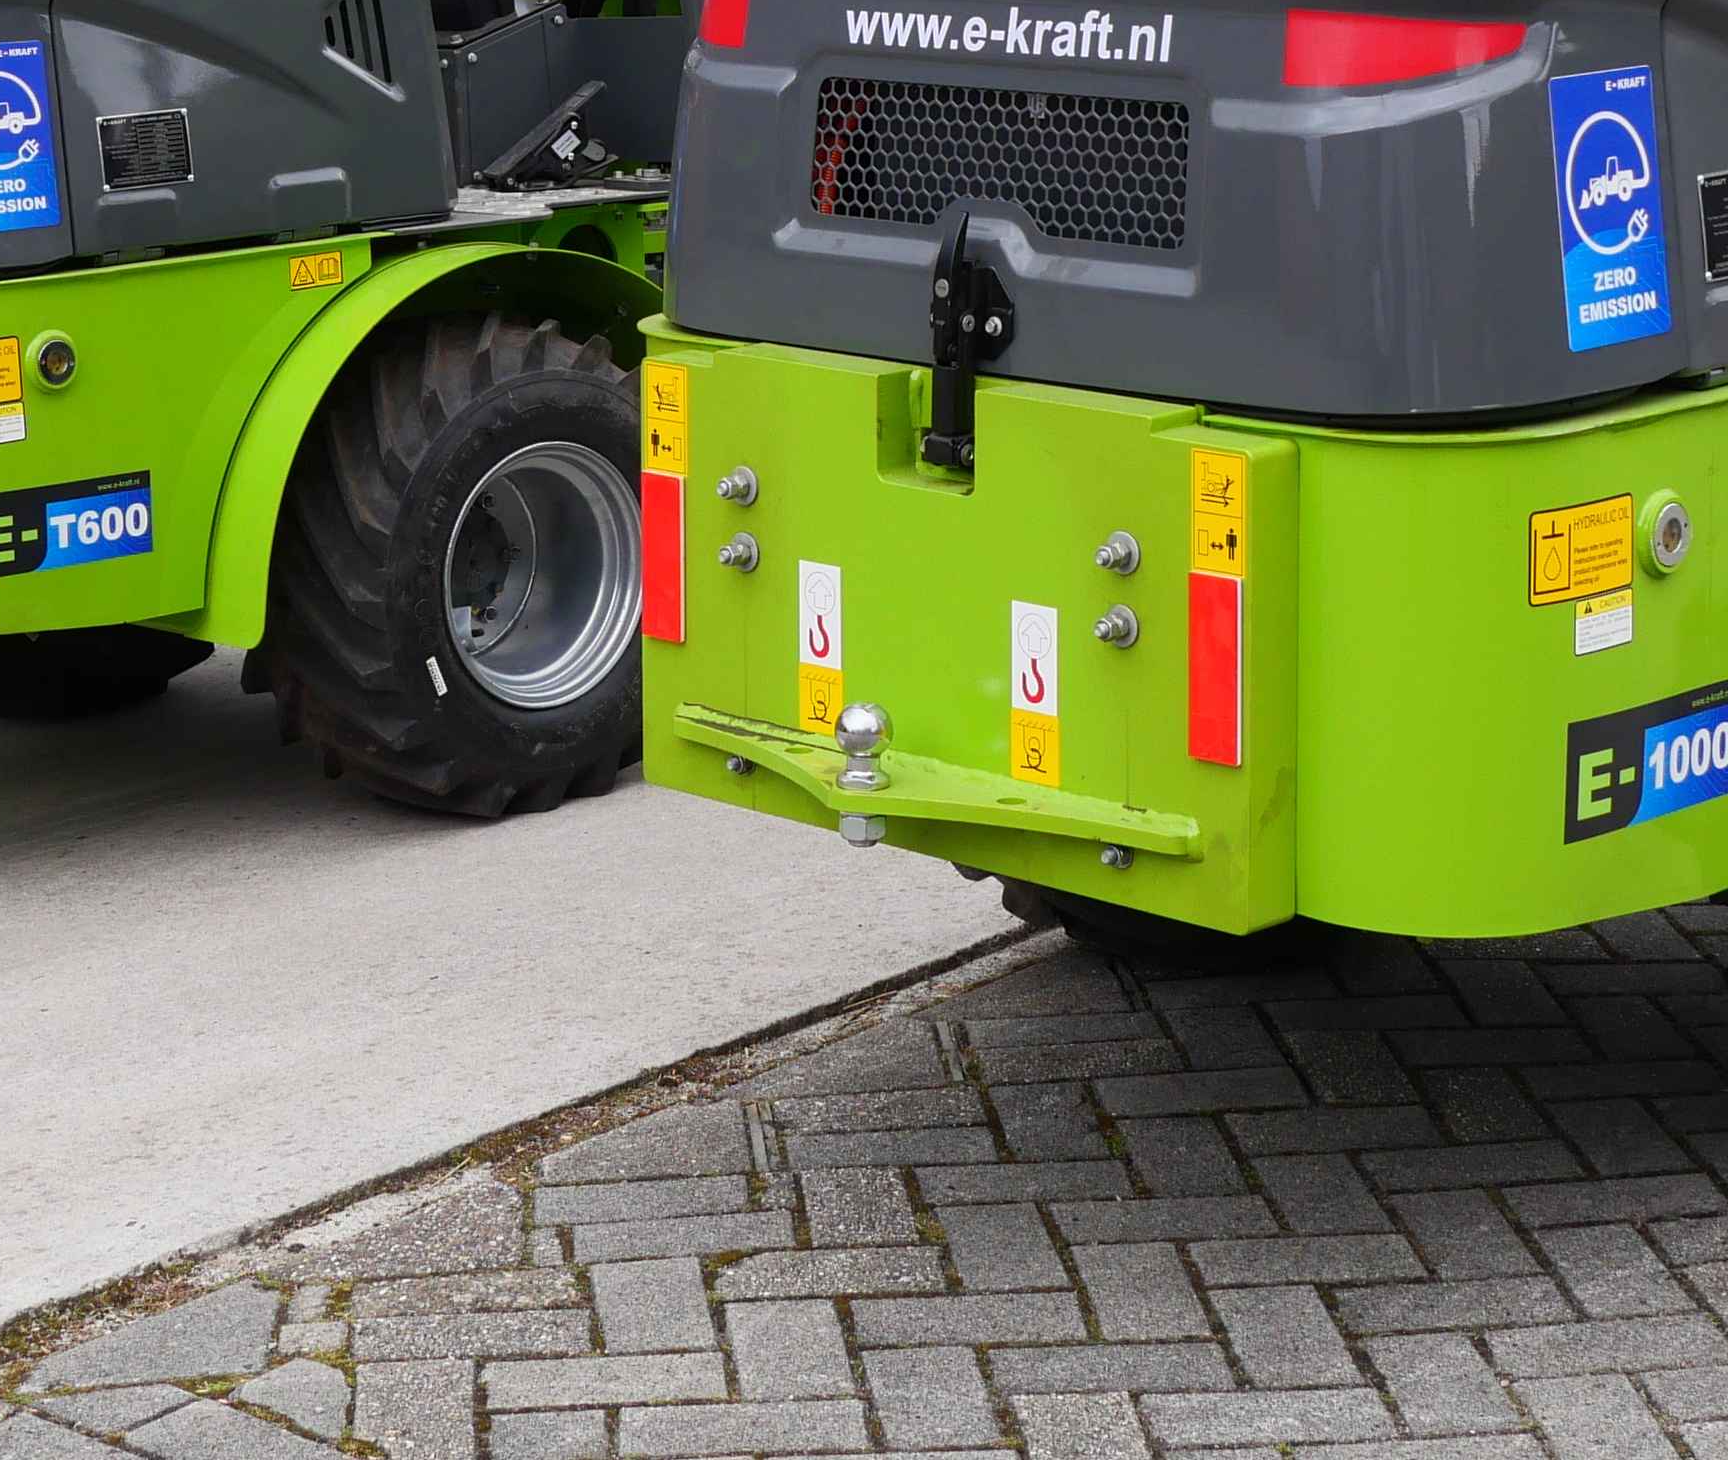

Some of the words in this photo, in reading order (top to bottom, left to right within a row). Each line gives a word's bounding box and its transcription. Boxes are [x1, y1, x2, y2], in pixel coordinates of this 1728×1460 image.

[846, 7, 1173, 63] www.e-kraft.nl
[1593, 266, 1636, 292] ZERO
[1579, 290, 1657, 324] EMISSION
[3, 345, 16, 355] OIL
[1573, 509, 1616, 530] HYDRAULIC
[1618, 506, 1630, 520] OIL
